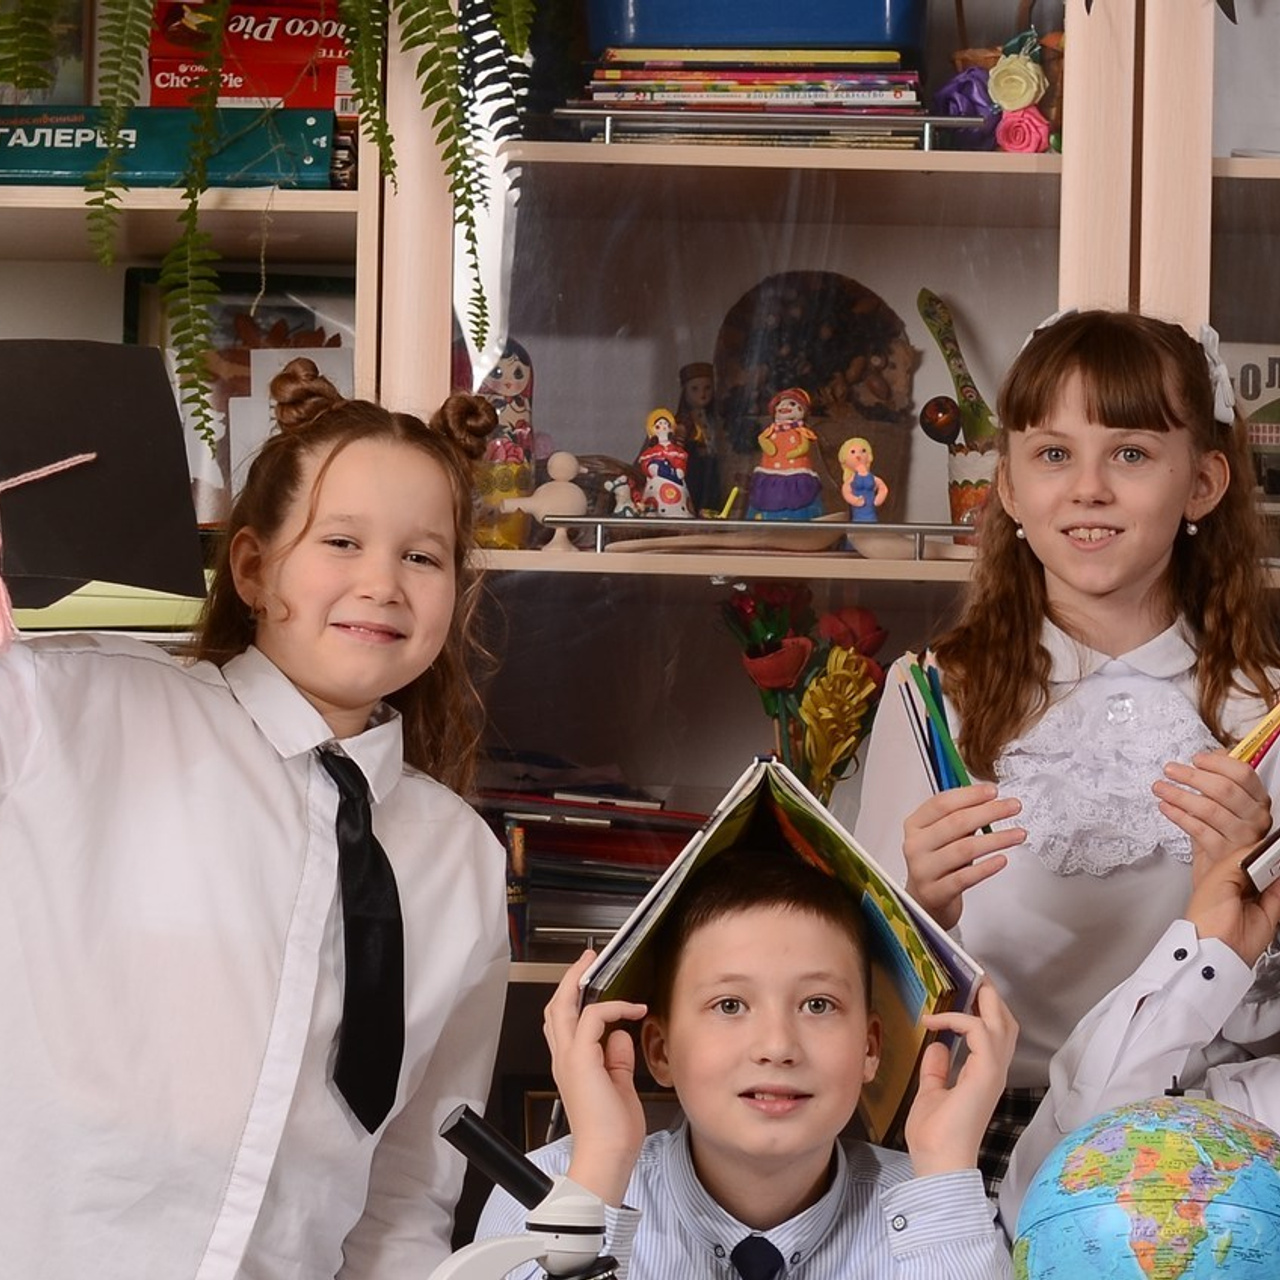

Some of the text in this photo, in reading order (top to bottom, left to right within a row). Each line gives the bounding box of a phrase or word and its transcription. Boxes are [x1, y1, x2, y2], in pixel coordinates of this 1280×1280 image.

[228, 15, 354, 44] oco Pie
[154, 72, 215, 89] Cho
